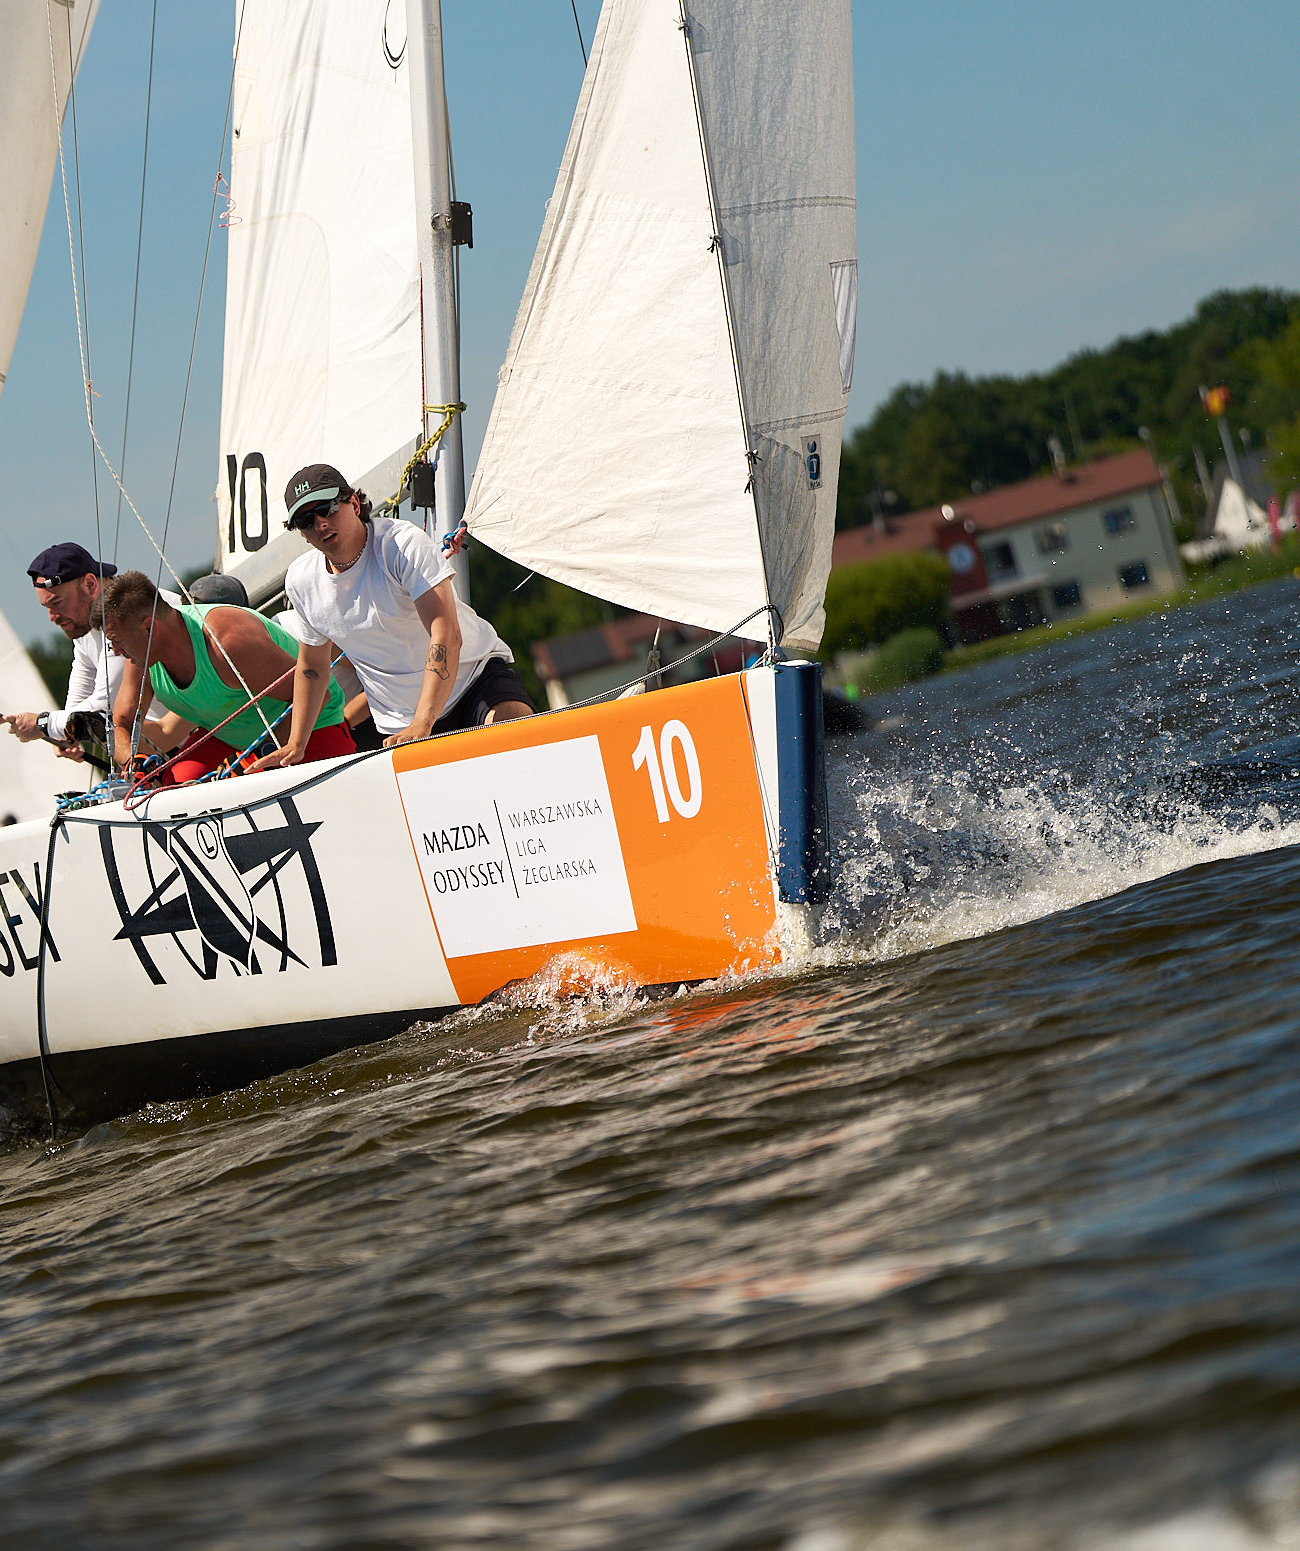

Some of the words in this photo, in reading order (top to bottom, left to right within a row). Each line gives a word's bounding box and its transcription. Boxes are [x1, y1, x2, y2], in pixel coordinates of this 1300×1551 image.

[226, 451, 269, 553] 10
[294, 480, 311, 496] HH
[631, 719, 703, 824] 10
[507, 798, 604, 830] WARSZAWSKA
[422, 822, 491, 856] MAZDA
[515, 837, 548, 858] LIGA
[433, 859, 506, 894] ODYSSEY
[522, 858, 598, 886] ŻEGLARSKA
